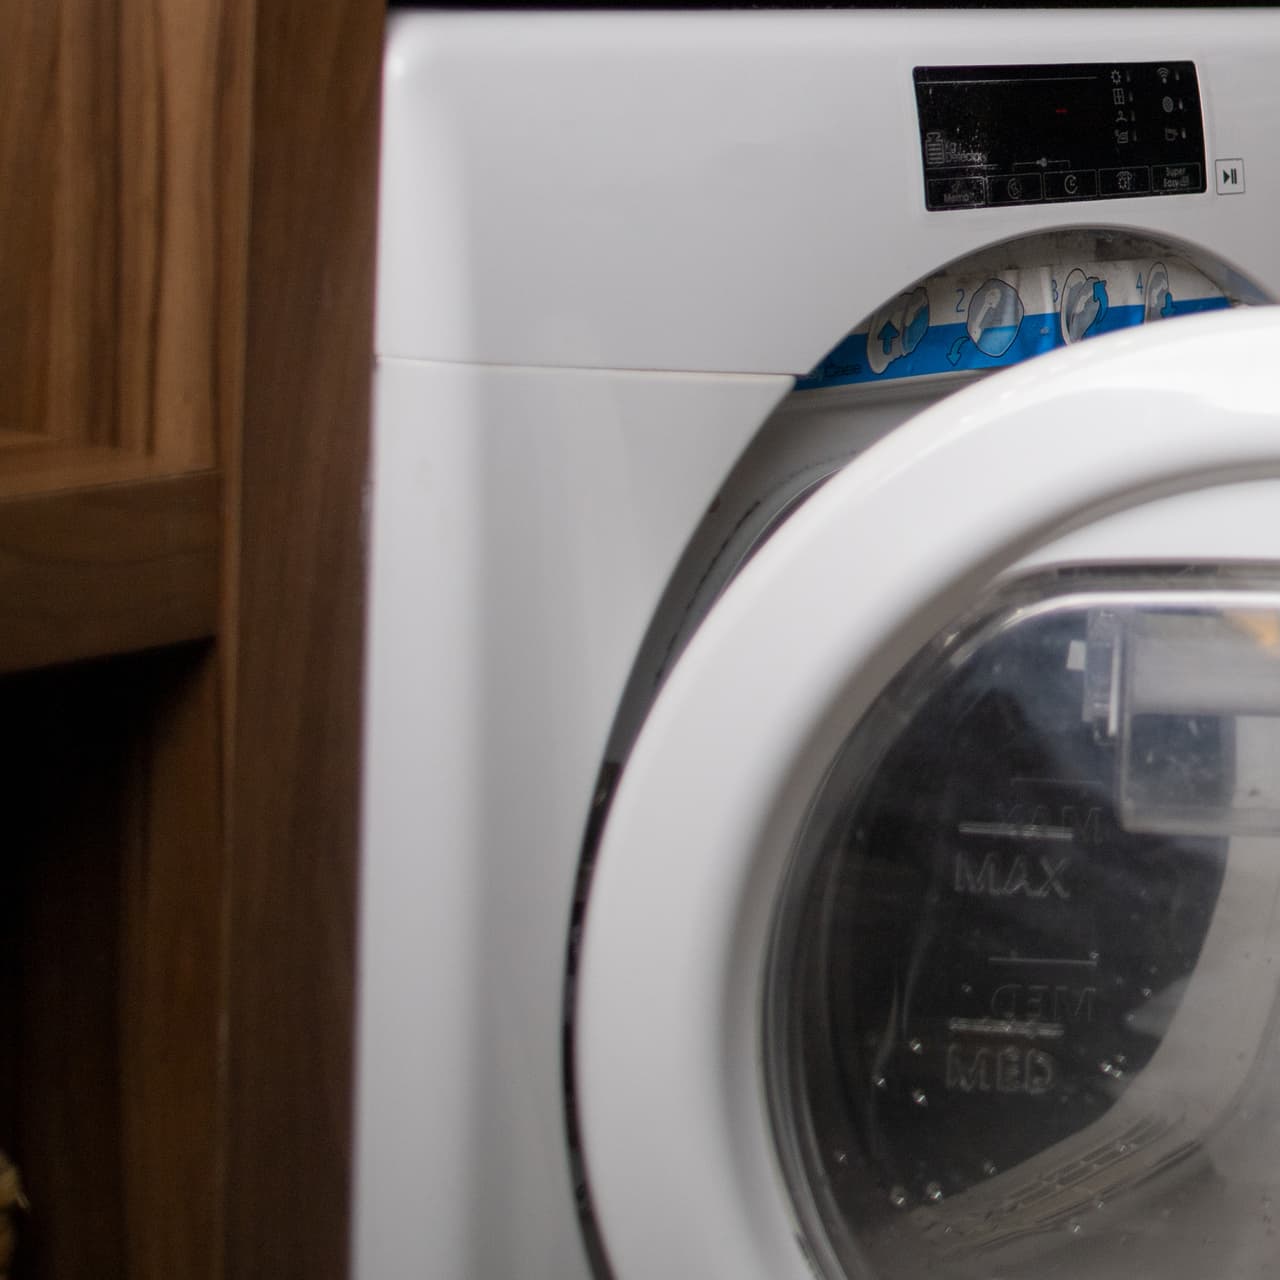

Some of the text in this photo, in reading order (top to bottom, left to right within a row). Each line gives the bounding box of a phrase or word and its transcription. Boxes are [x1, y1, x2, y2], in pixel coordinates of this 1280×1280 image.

[956, 288, 966, 313] 2
[1135, 271, 1144, 296] 4
[954, 850, 1071, 898] MAX
[944, 1042, 1056, 1096] MED
